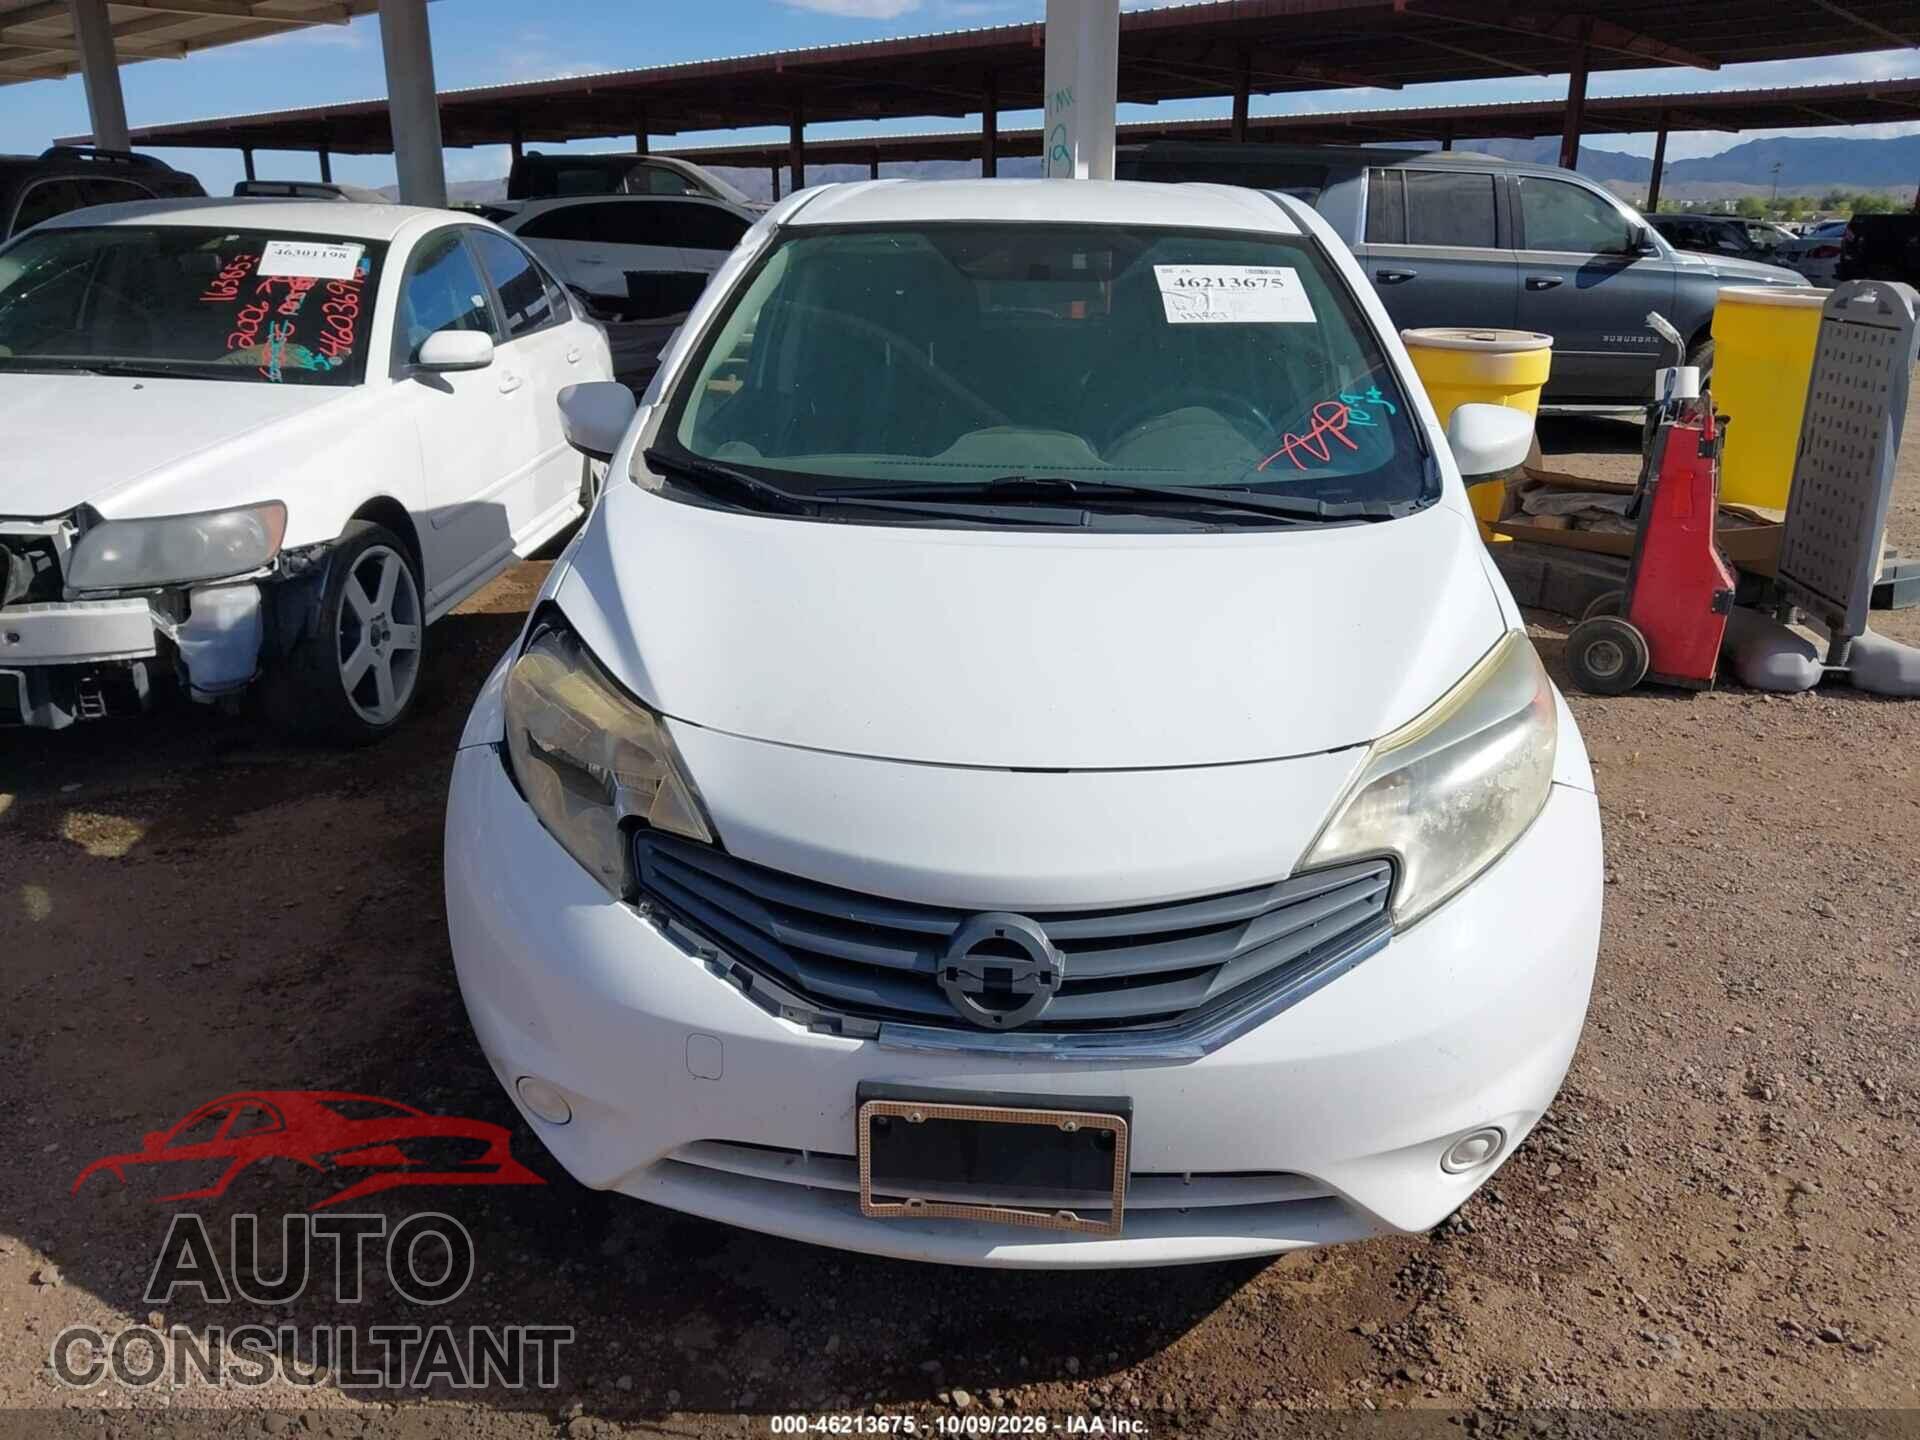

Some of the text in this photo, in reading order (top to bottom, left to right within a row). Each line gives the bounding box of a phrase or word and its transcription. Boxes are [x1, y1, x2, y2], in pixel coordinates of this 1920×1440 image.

[273, 249, 348, 259] 46301198
[1172, 276, 1286, 289] 46213675
[1602, 335, 1659, 343] SUBURBAN
